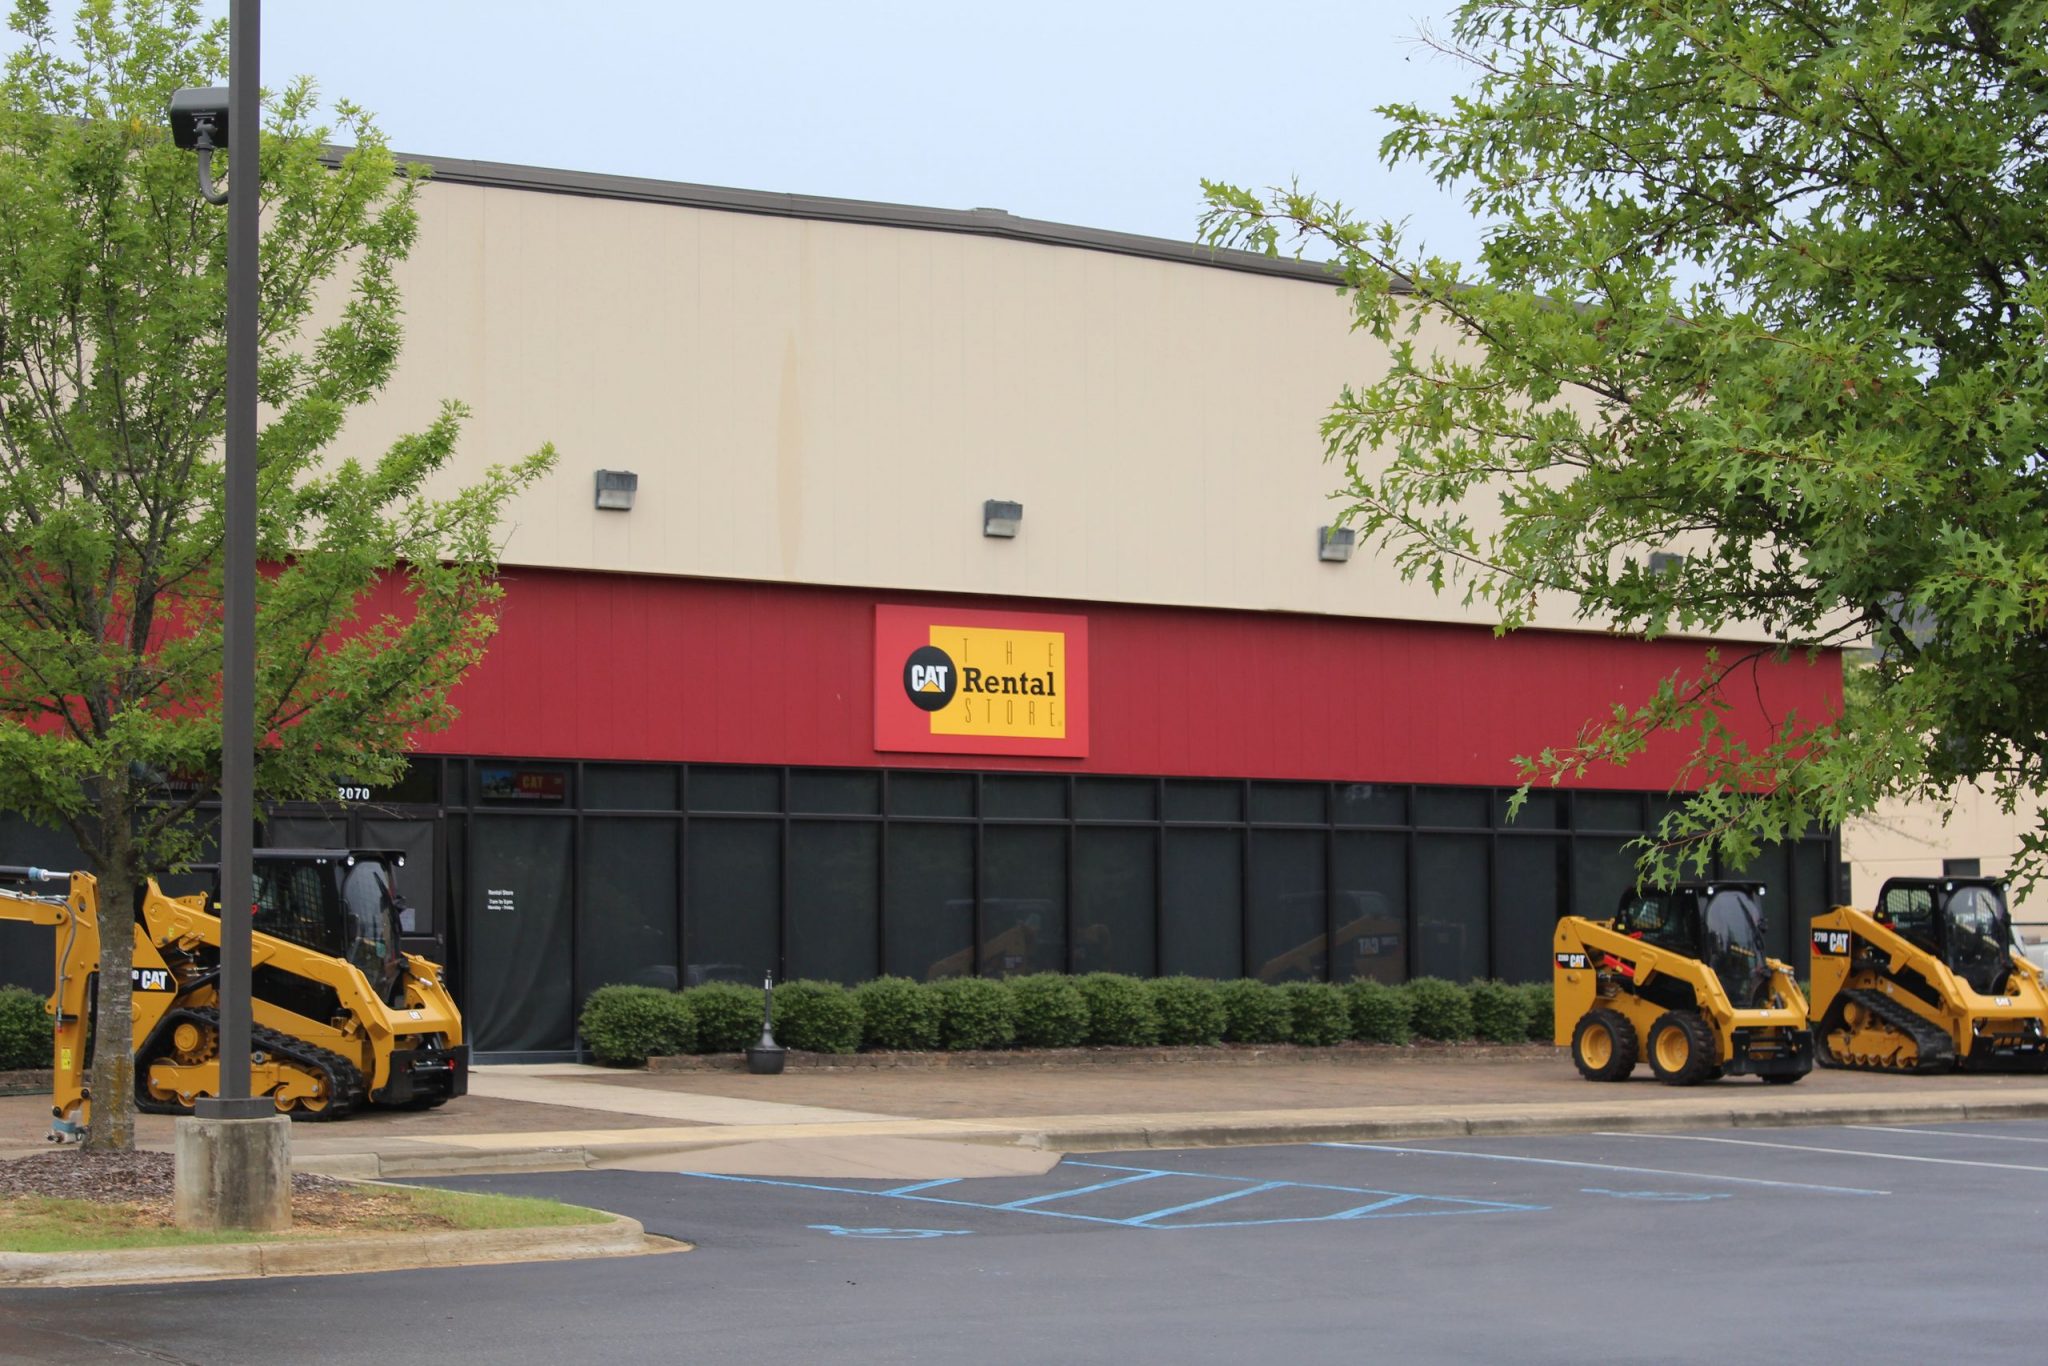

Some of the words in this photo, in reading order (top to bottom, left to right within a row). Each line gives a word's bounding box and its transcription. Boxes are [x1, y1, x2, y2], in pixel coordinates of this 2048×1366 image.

[962, 637, 1055, 668] THE
[911, 664, 948, 693] CAT
[962, 667, 1056, 697] Rental
[965, 697, 1056, 727] STORE
[522, 775, 544, 789] CAT
[338, 787, 370, 800] 2070
[1829, 932, 1848, 952] CAT
[1570, 954, 1585, 968] CAT
[141, 970, 168, 991] CAT
